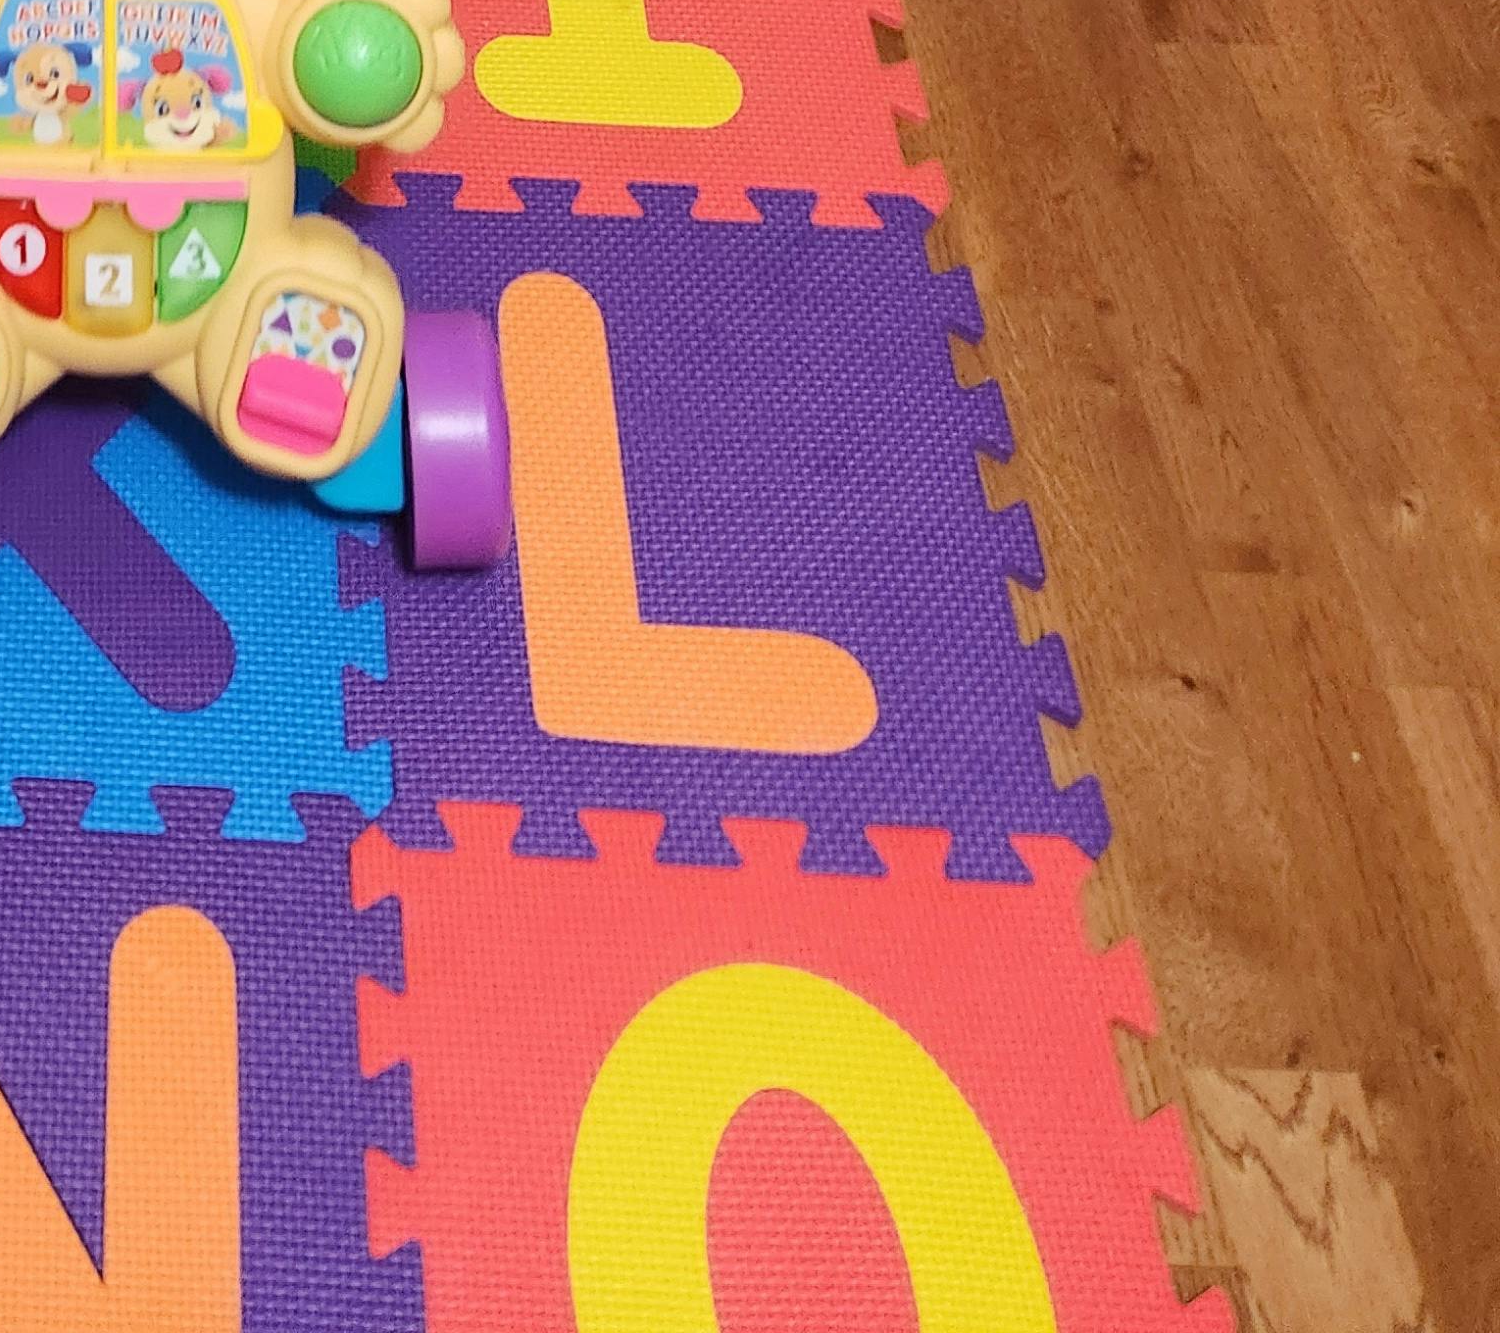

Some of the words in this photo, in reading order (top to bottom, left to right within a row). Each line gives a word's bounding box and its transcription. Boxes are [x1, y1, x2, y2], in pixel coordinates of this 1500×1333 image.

[12, 231, 29, 267] 1
[186, 240, 208, 276] 3
[97, 262, 122, 300] 2
[498, 271, 879, 755] L
